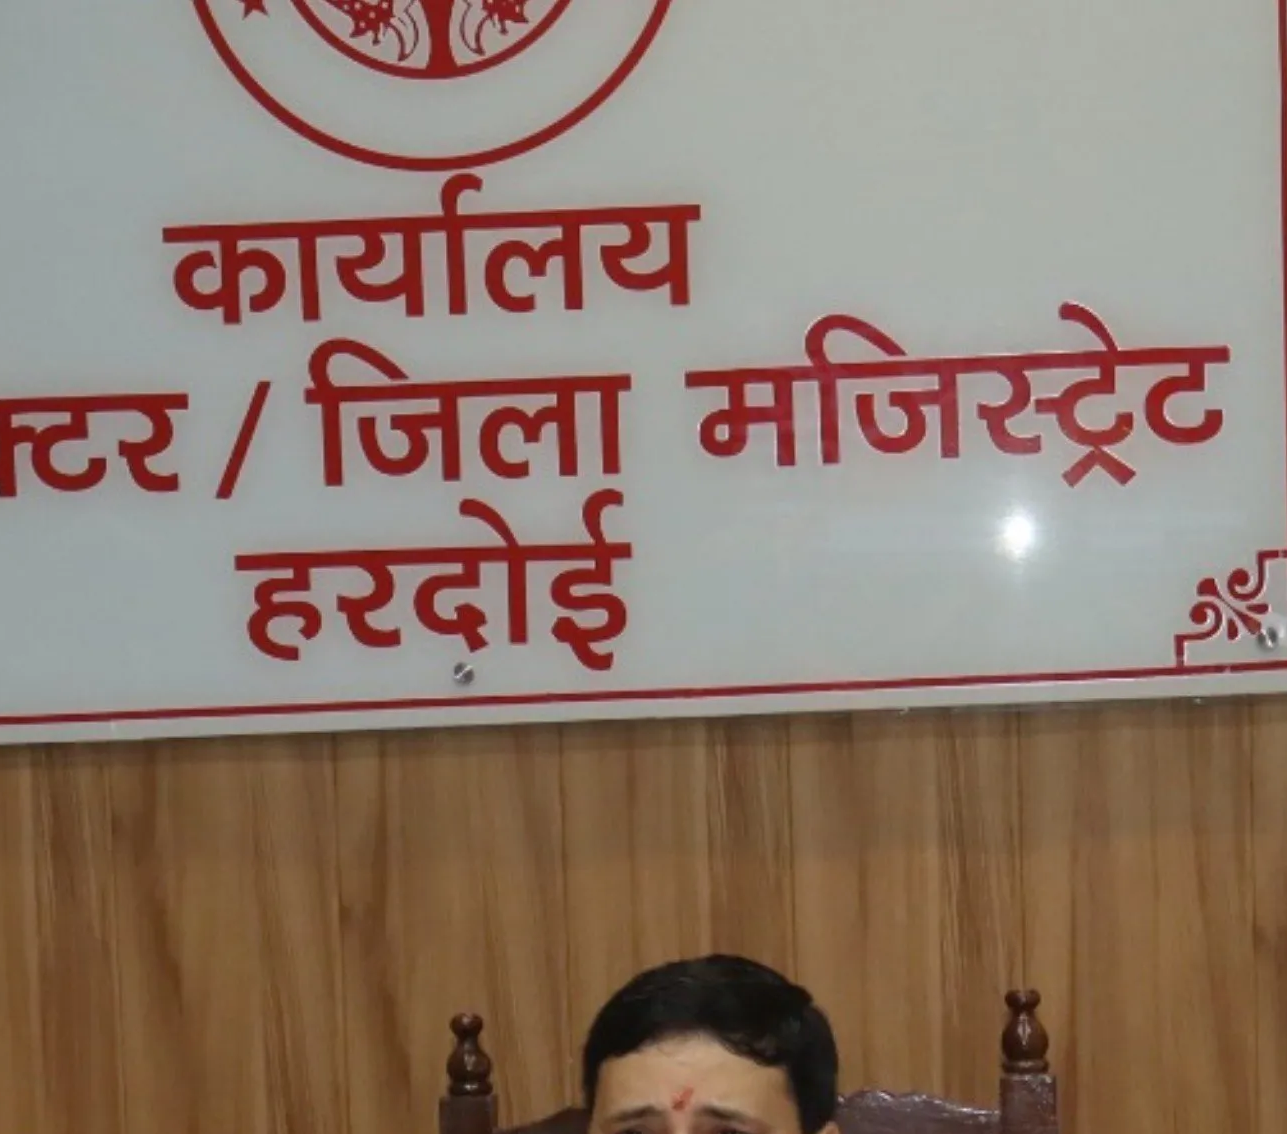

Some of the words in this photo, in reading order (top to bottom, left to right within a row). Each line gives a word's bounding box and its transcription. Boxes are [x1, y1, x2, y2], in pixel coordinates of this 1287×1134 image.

[164, 173, 700, 323] कार्यालय
[219, 382, 269, 498] /
[305, 339, 631, 485] जिला
[687, 304, 1229, 482] मजिस्ट्रेट
[236, 489, 631, 670] हरदोई
